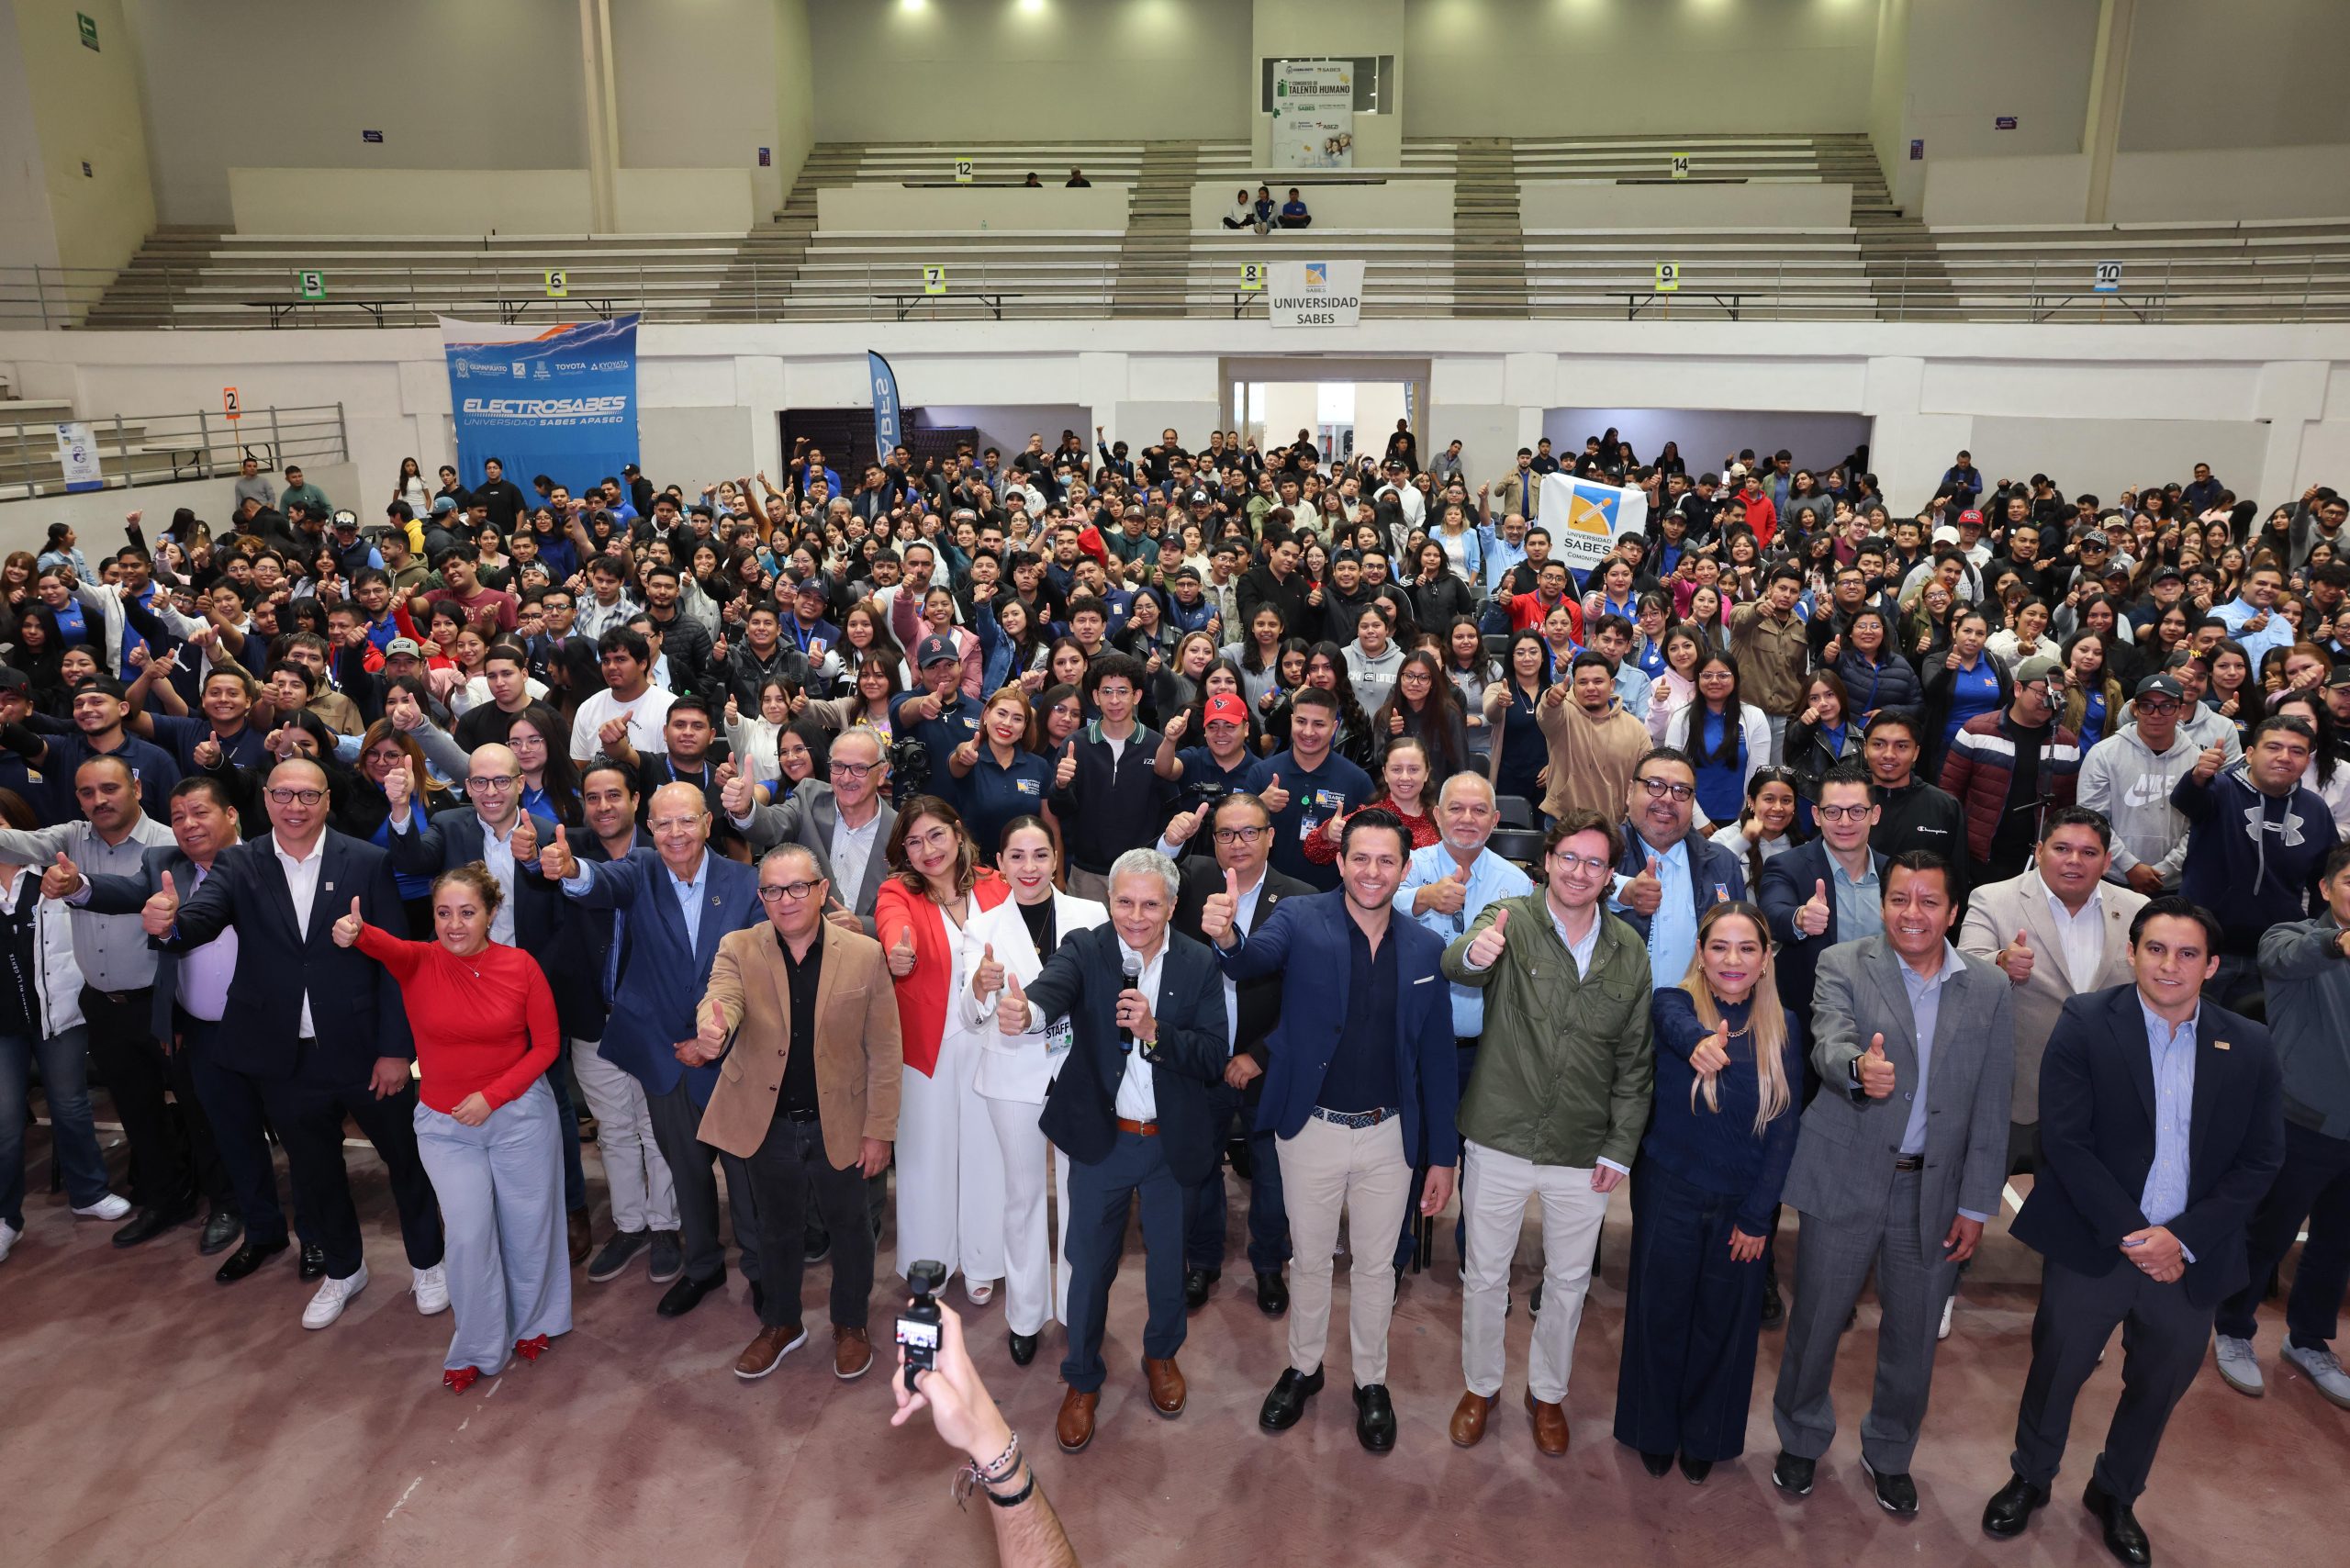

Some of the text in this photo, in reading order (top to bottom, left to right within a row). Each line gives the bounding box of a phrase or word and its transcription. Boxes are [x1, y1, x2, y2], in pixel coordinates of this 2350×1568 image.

[1289, 85, 1350, 94] TALENTO HUMANO
[957, 162, 971, 175] 12
[1673, 158, 1688, 172] 14
[551, 273, 562, 288] 6
[928, 269, 939, 286] 7
[1246, 265, 1256, 282] 8
[1662, 265, 1673, 282] 9
[2098, 264, 2120, 282] 10
[306, 274, 319, 291] 5
[1273, 297, 1359, 308] UNIVERSIDAD
[1296, 313, 1335, 324] SABES
[227, 393, 237, 410] 2
[463, 396, 627, 415] ELECTROSABES
[464, 416, 623, 427] UNIVERSIDAD SABES APASEO
[1566, 531, 1613, 544] UNIVERSIDAD
[1563, 537, 1612, 555] SABES
[1567, 551, 1603, 563] COMONFOR
[2134, 773, 2176, 793] NIKE
[1917, 825, 1948, 834] Champion
[1046, 1022, 1069, 1039] STAFF
